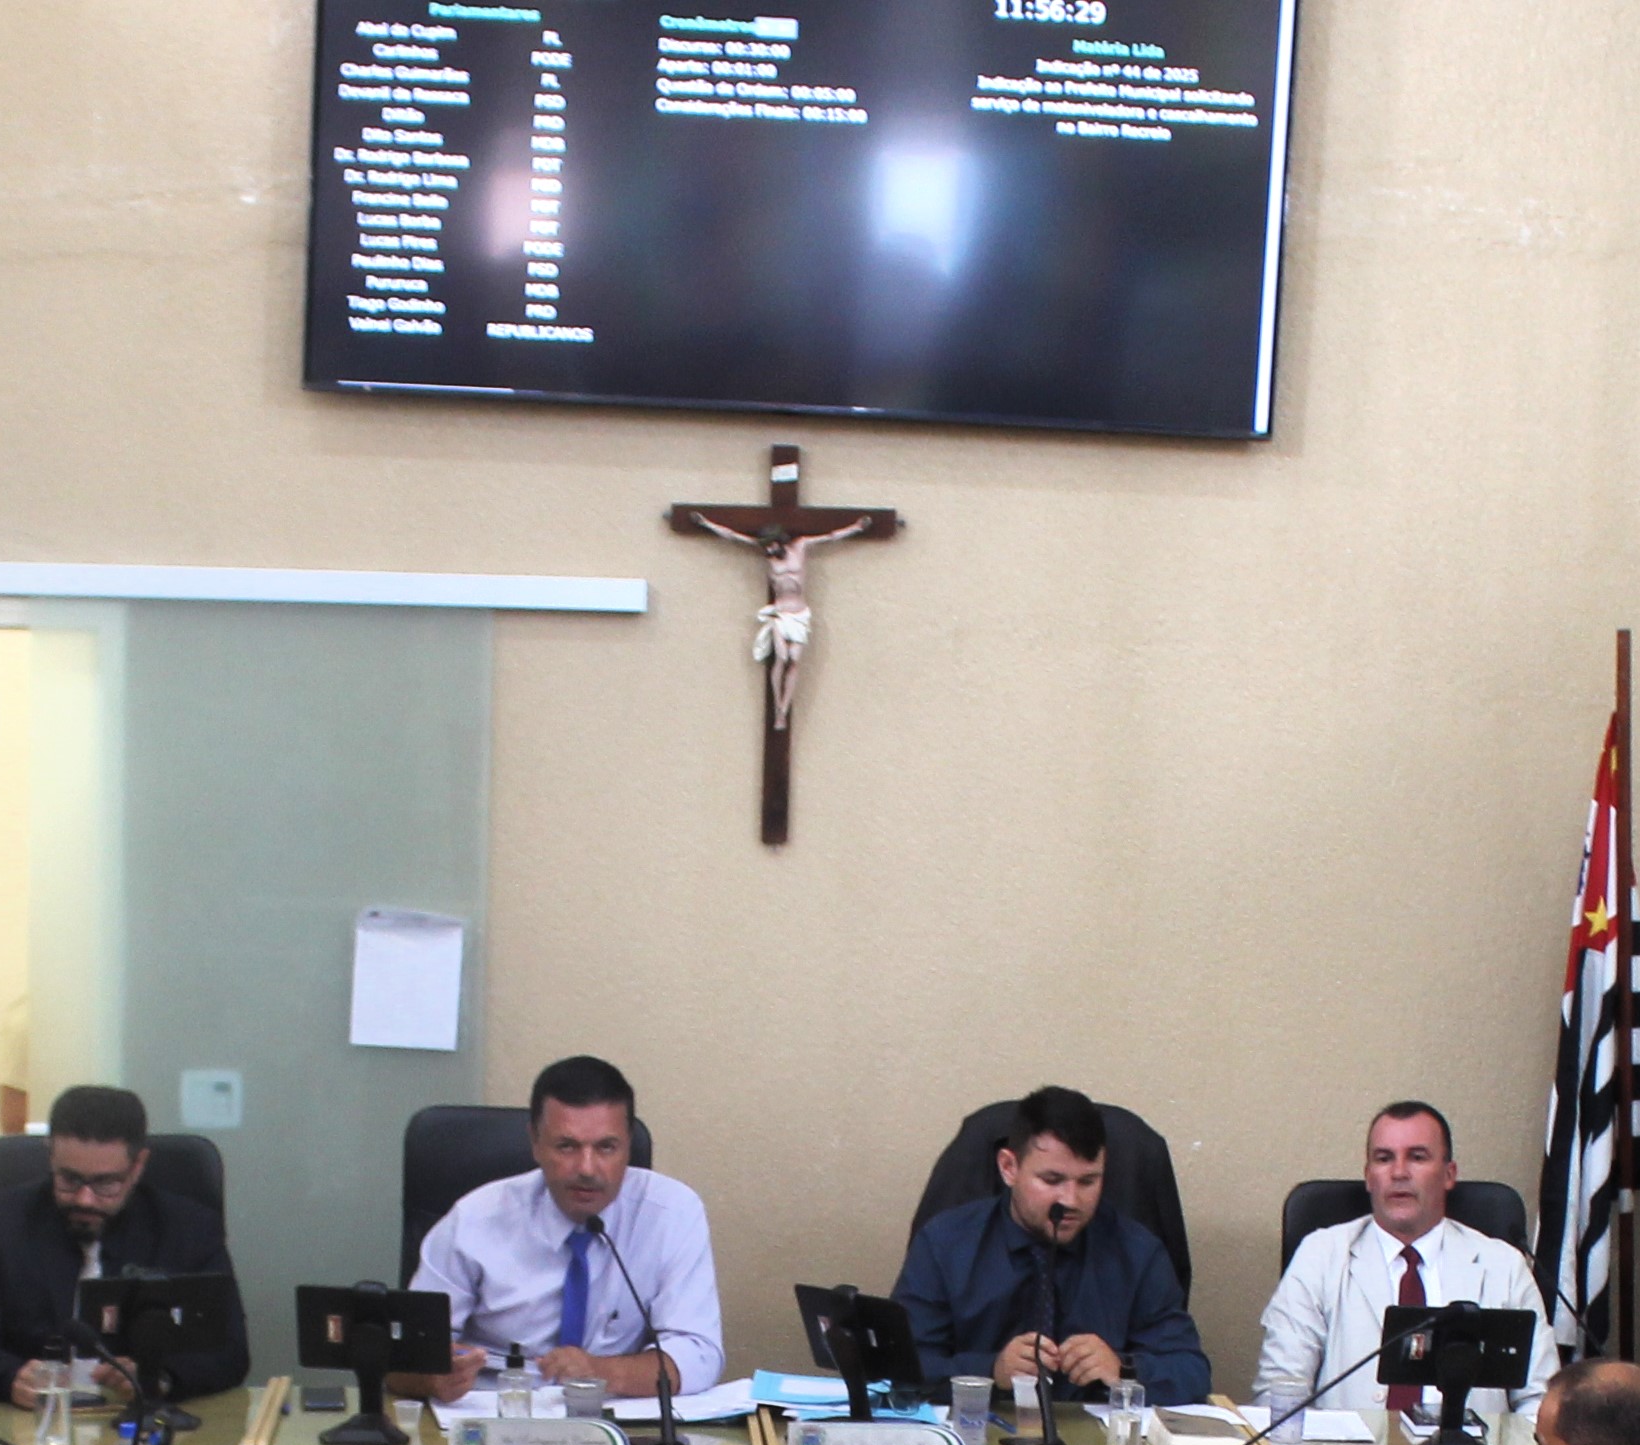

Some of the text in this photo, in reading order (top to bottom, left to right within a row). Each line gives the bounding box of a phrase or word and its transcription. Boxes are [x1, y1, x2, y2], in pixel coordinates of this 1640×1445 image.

[429, 3, 541, 22] Parlamentares
[994, 0, 1107, 25] 11:56:29
[356, 22, 390, 38] Abel
[543, 31, 563, 47] PL
[372, 43, 439, 61] Carlinhos
[658, 38, 723, 55] Discurso:
[1072, 40, 1165, 59] Matéria Lida
[531, 51, 572, 69] PODE
[656, 58, 710, 76] Aparte:
[340, 63, 470, 84] Charles Guimarães
[1035, 59, 1101, 78] Indicação
[1122, 65, 1142, 79] 44
[1142, 66, 1162, 81] de
[1162, 67, 1199, 83] 2025
[540, 73, 561, 90] PL
[656, 78, 715, 96] Questão
[715, 81, 735, 97] de
[735, 82, 790, 99] Ordem:
[977, 75, 1255, 107] Indicação ao Prefeito Municipal solicitando
[655, 97, 754, 120] Considerações
[754, 103, 802, 120] Finais:
[970, 97, 1258, 127] serviço de motoniveladora e cascalhamento
[394, 129, 444, 146] Santos
[1056, 122, 1076, 135] no
[1077, 121, 1120, 138] Bairro
[530, 135, 566, 153] MDB
[334, 147, 470, 169] Dr. Rodrigo Barbosa
[344, 169, 458, 190] Dr. Rodrigo Lima
[357, 212, 399, 229] Lucas
[360, 233, 438, 251] Lucas Pires
[522, 240, 565, 258] PODE
[351, 254, 444, 272] Paulinho Dias
[525, 283, 560, 299] MDB
[347, 295, 446, 314] Tiago Godinho
[392, 319, 442, 335] Galvão
[486, 323, 594, 342] REPUBLICANOS
